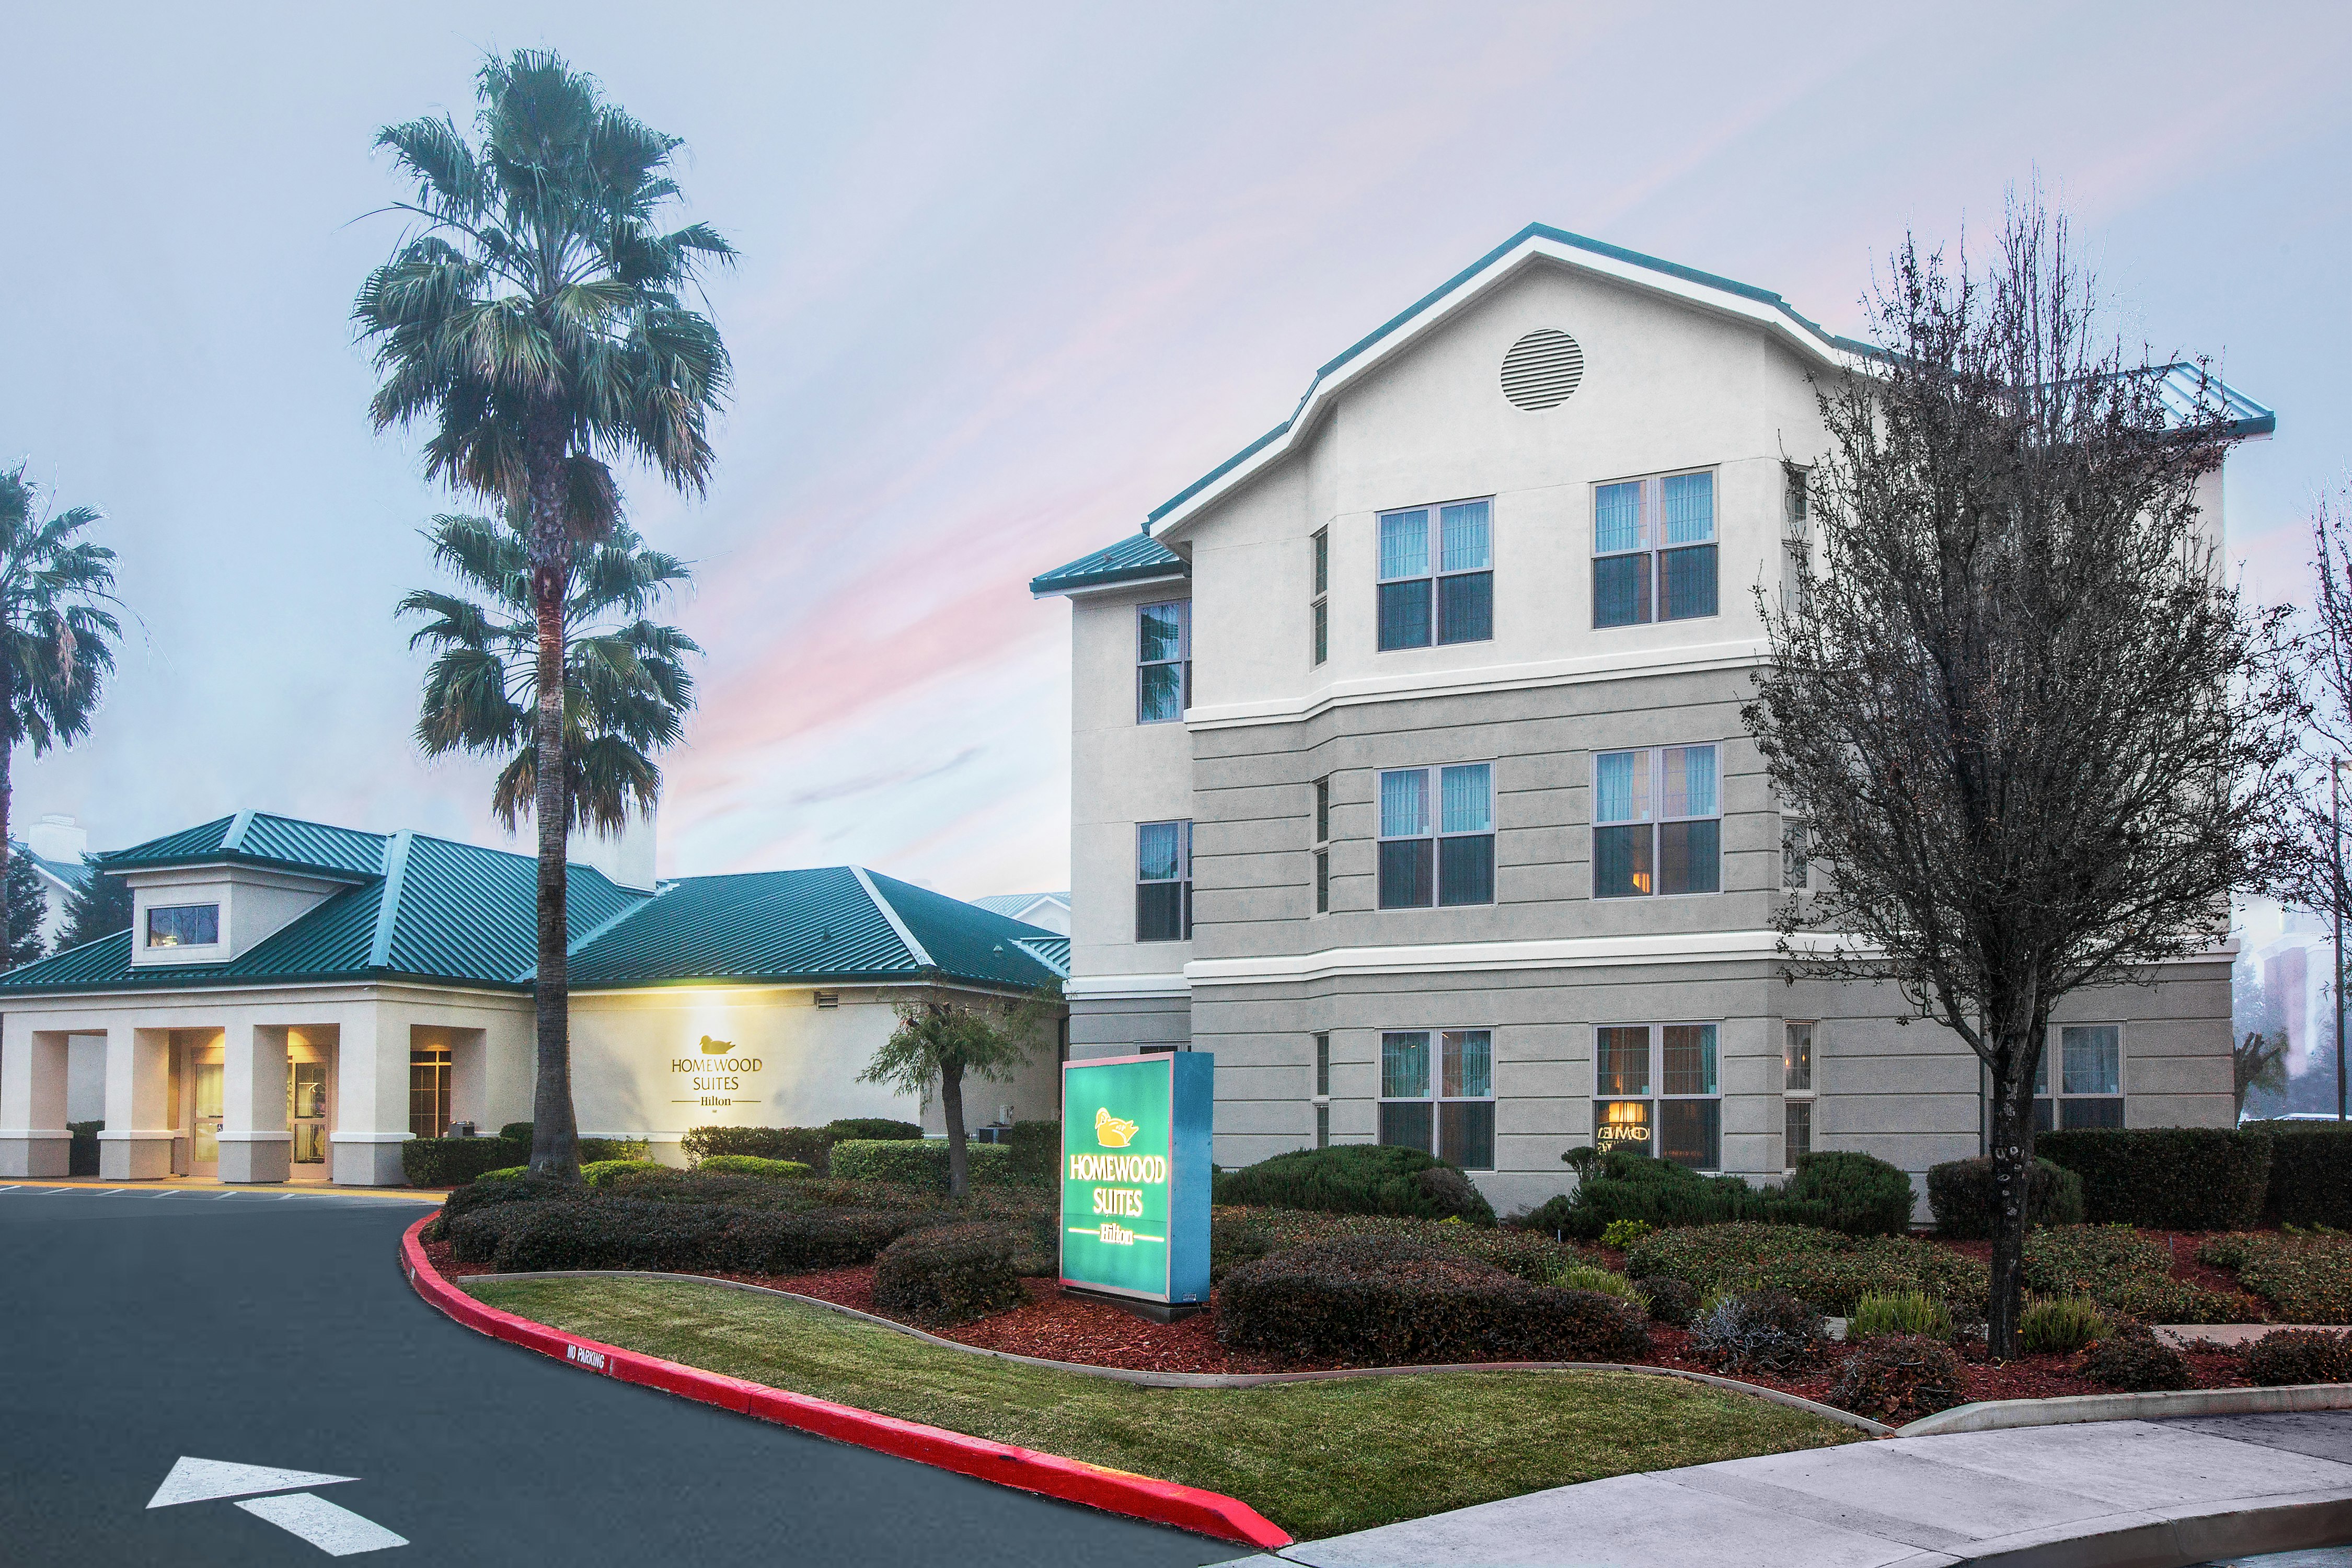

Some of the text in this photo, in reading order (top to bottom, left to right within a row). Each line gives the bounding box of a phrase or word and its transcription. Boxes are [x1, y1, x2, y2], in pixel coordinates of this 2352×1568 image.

[672, 1058, 763, 1072] HOMEWOOD
[694, 1077, 739, 1090] SUITES
[701, 1096, 731, 1106] Hilton
[1070, 1155, 1166, 1183] HOMEWOOD
[1093, 1187, 1143, 1217] SUITES
[1100, 1223, 1134, 1245] Hilton
[567, 1344, 605, 1369] NO PARKING
